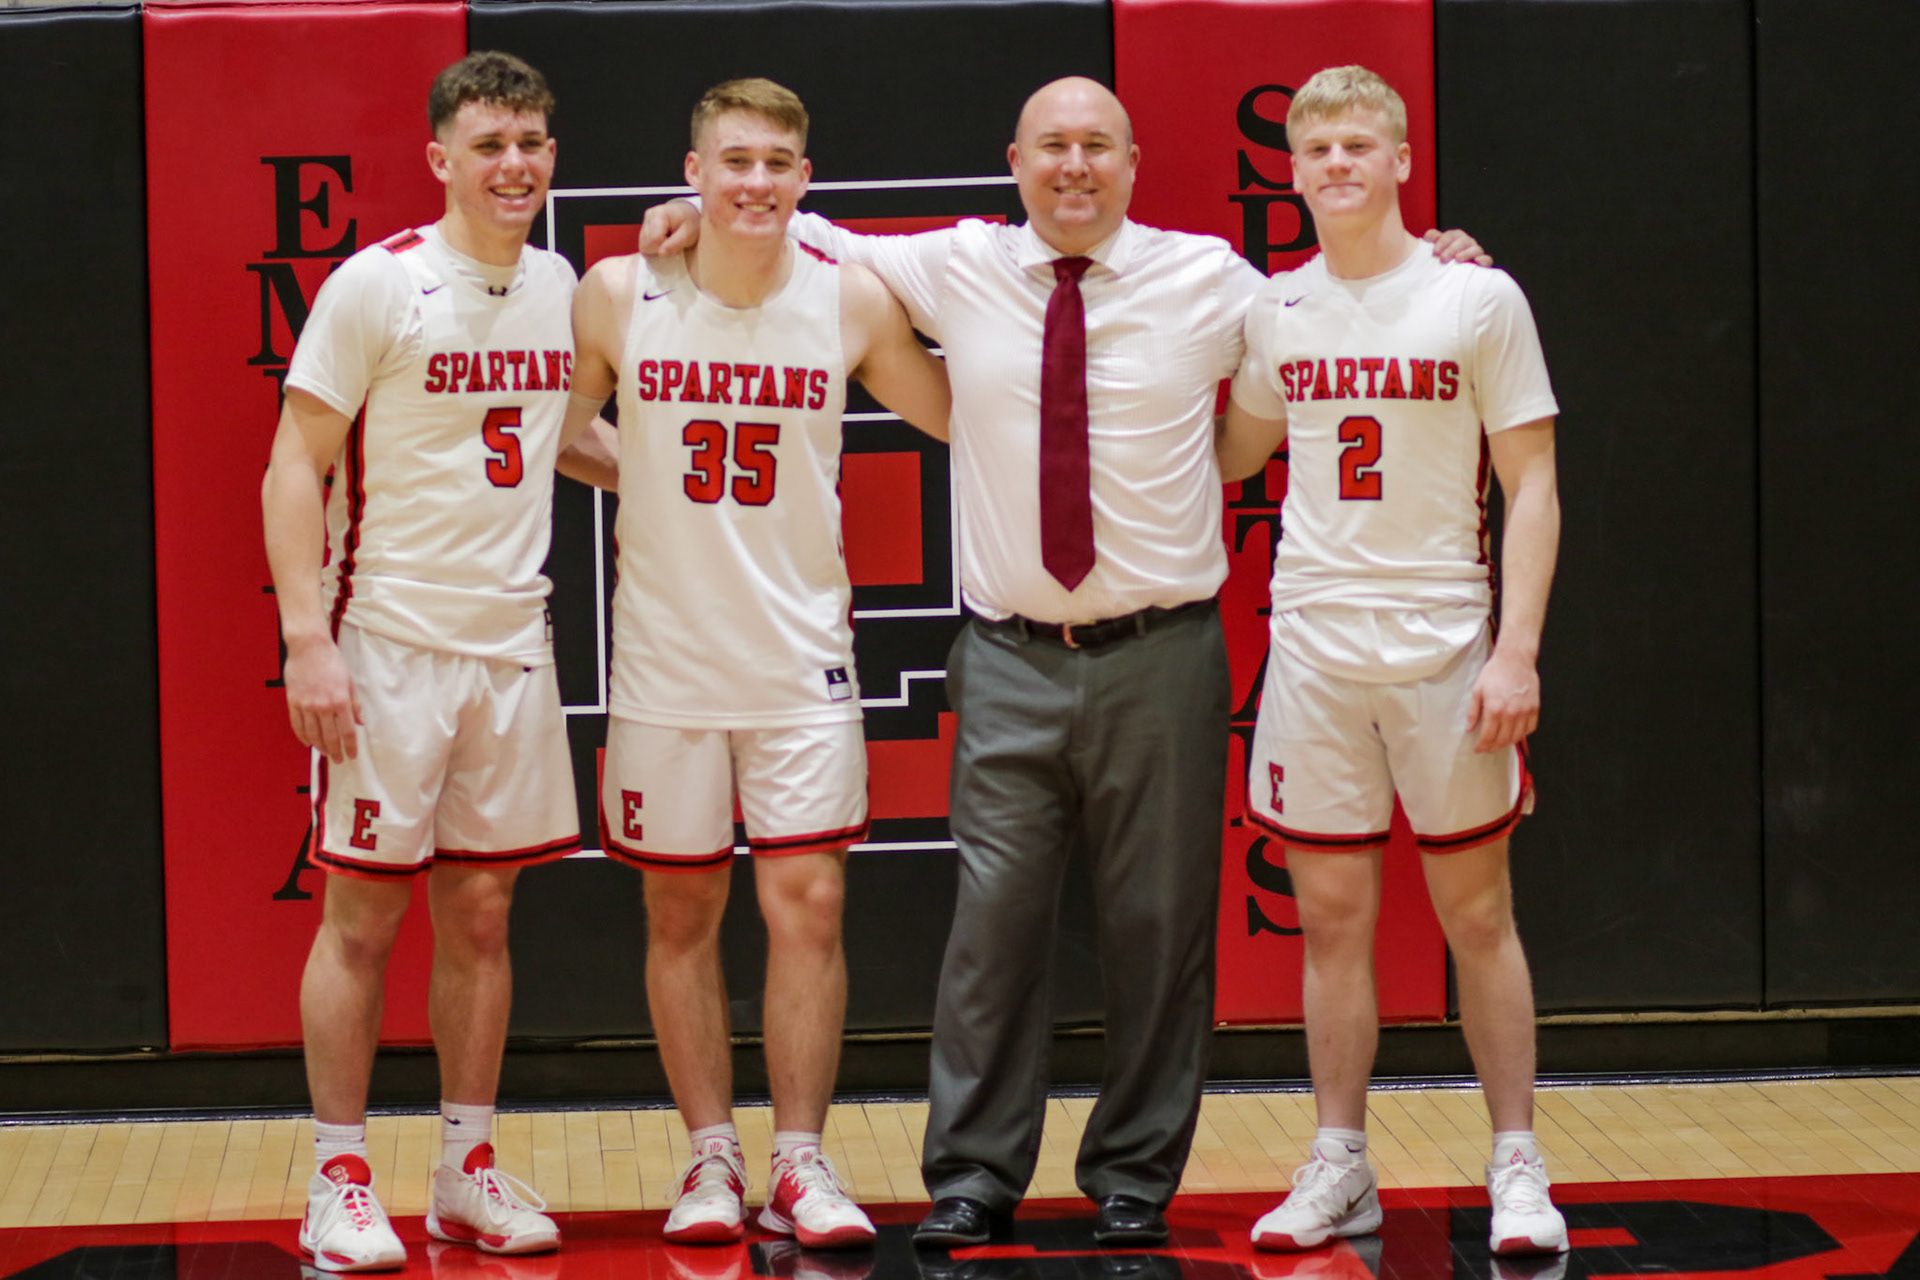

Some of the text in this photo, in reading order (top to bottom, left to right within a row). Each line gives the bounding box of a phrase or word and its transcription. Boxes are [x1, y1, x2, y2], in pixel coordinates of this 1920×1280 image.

[424, 350, 573, 393] SPARTANS
[638, 360, 829, 410] SPARTANS
[1278, 357, 1460, 402] SPARTANS
[482, 406, 524, 488] 5
[682, 419, 781, 507] 35
[1338, 415, 1382, 501] 2
[1268, 760, 1284, 816] E
[349, 798, 381, 850] E
[621, 789, 643, 841] E
